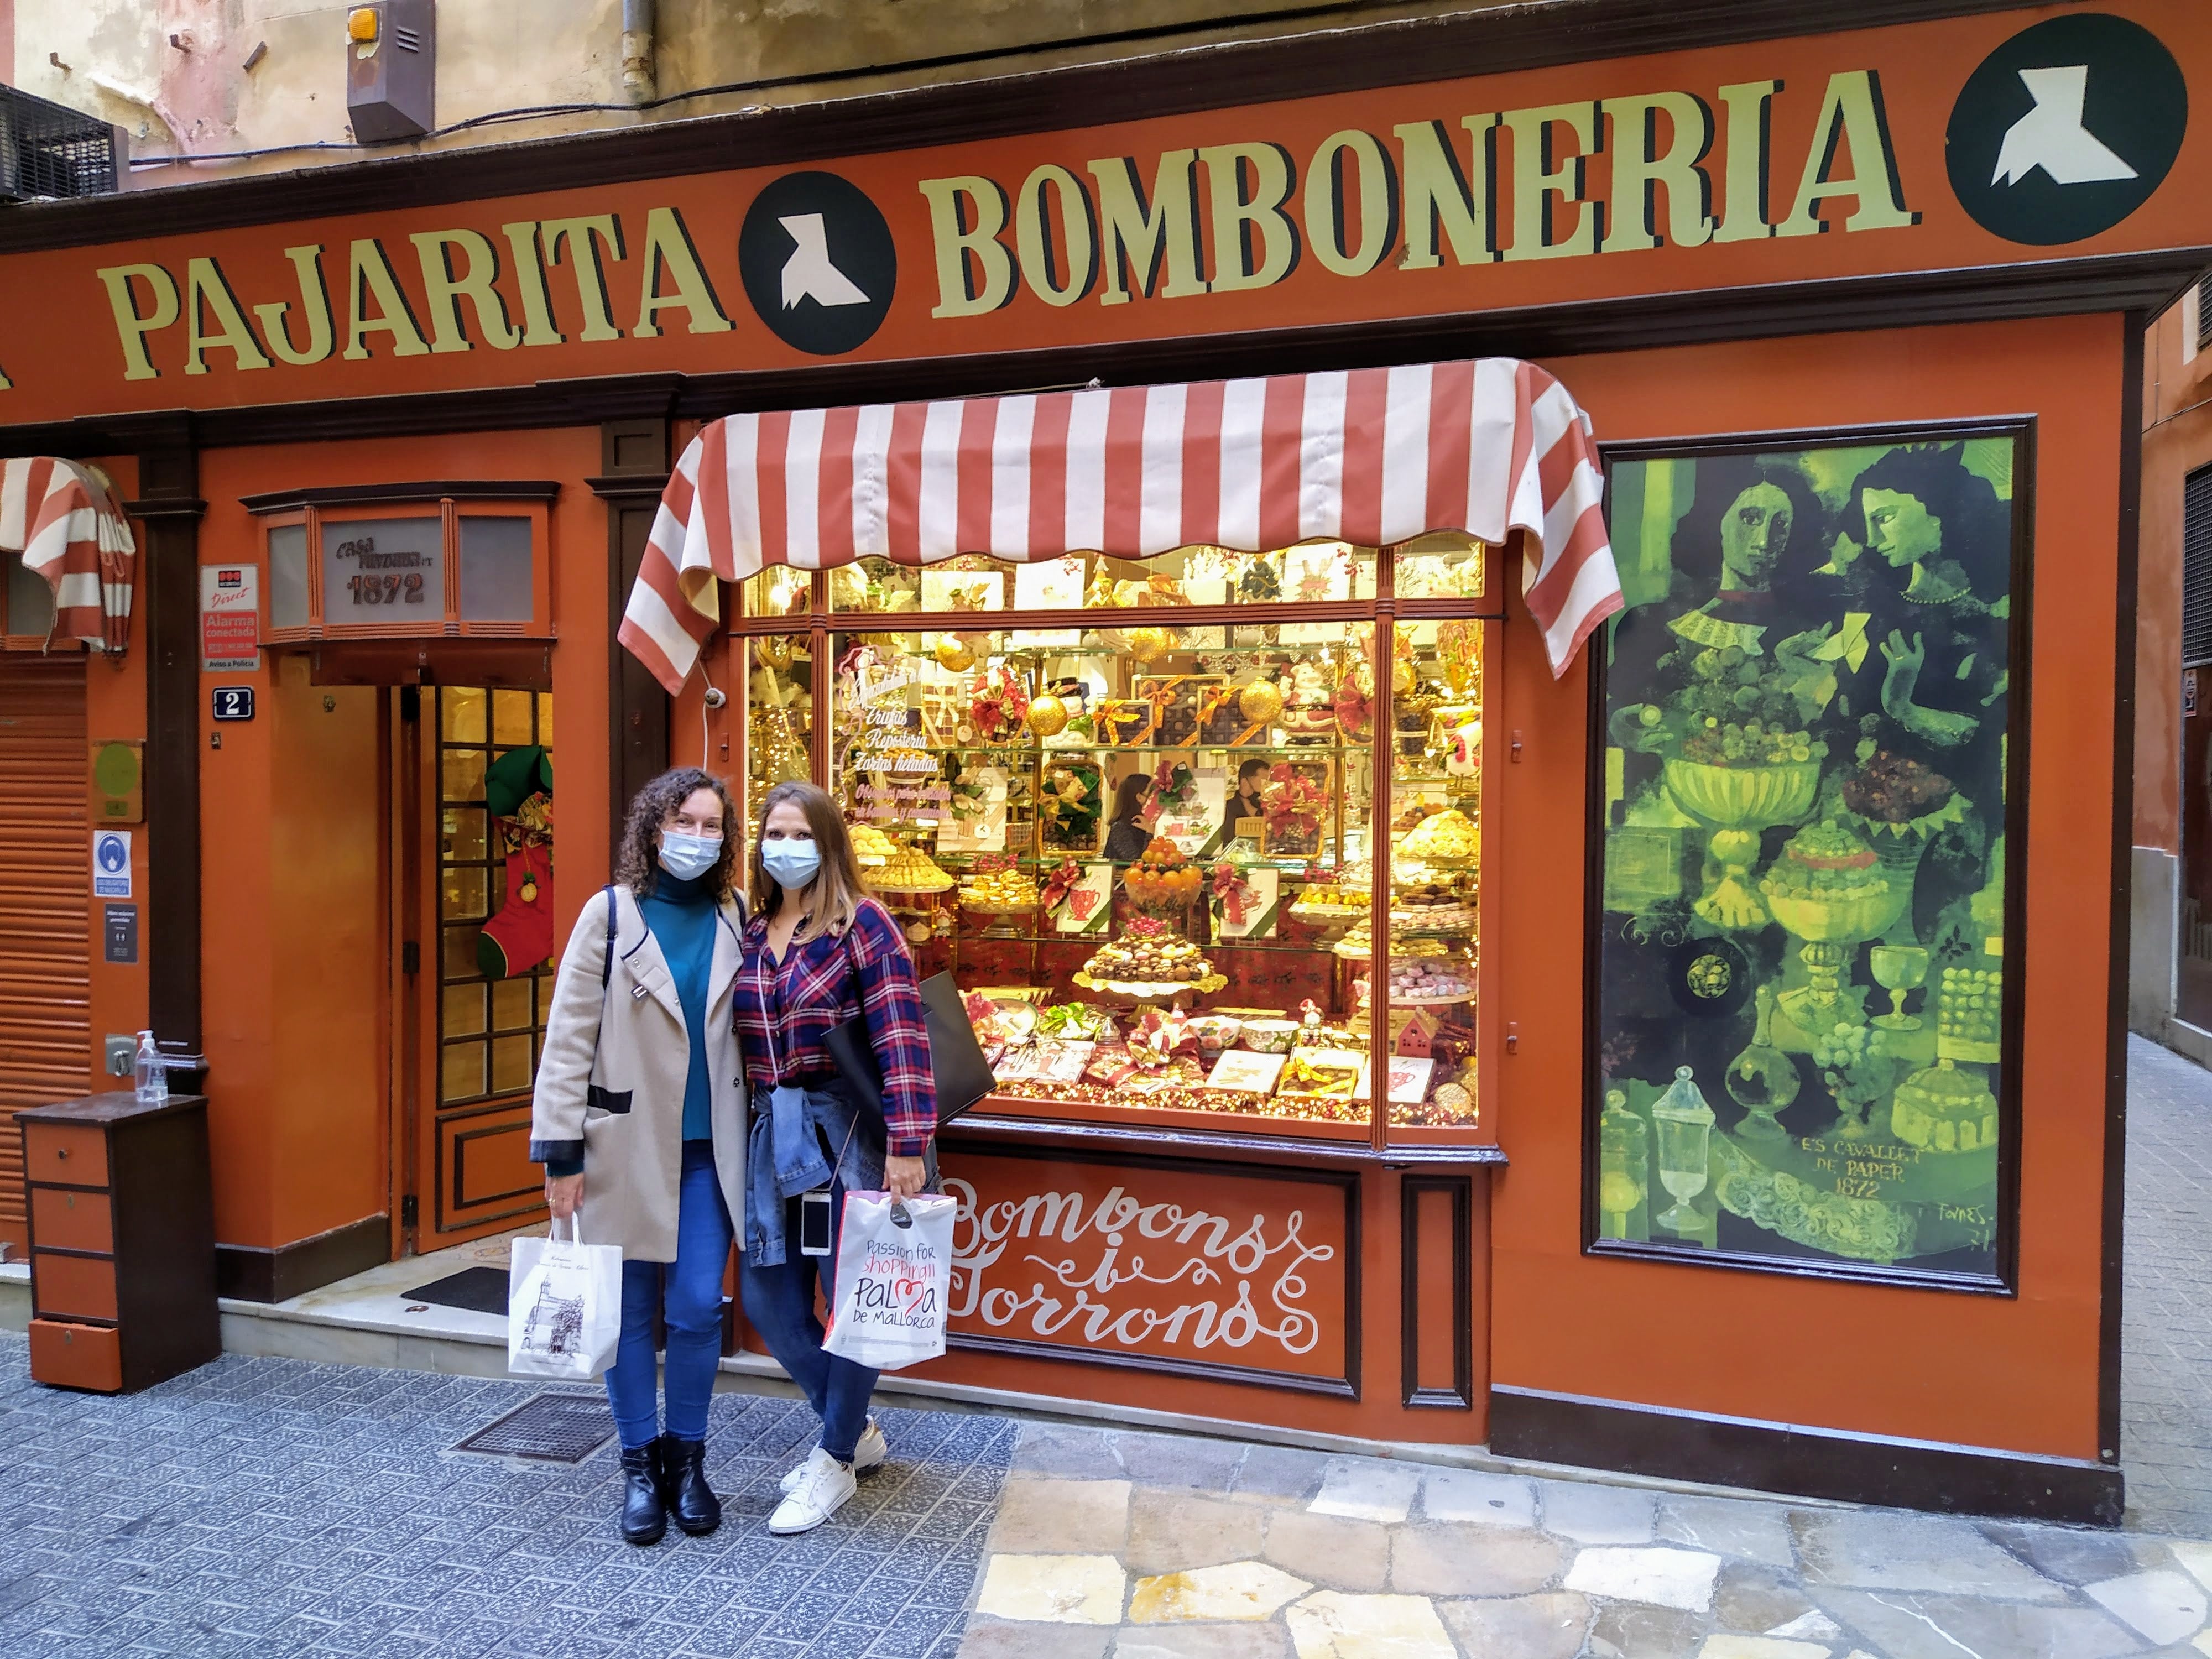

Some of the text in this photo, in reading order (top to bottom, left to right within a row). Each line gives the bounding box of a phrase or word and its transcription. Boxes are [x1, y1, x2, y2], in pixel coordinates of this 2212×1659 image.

[918, 69, 1922, 320] BOMBONERIA
[97, 207, 734, 380] PAJARITA
[212, 587, 251, 608] Direct
[347, 573, 424, 604] 1872
[206, 614, 254, 627] Alarma
[206, 627, 254, 637] conectada
[226, 692, 239, 714] 2
[865, 705, 908, 730] Trufas
[894, 753, 938, 772] heladas
[1801, 1136, 1923, 1164] ES CAVALLET
[1812, 1157, 1905, 1183] DE PAPER
[1836, 1176, 1880, 1198] 1872
[938, 1178, 1266, 1274] Bombons
